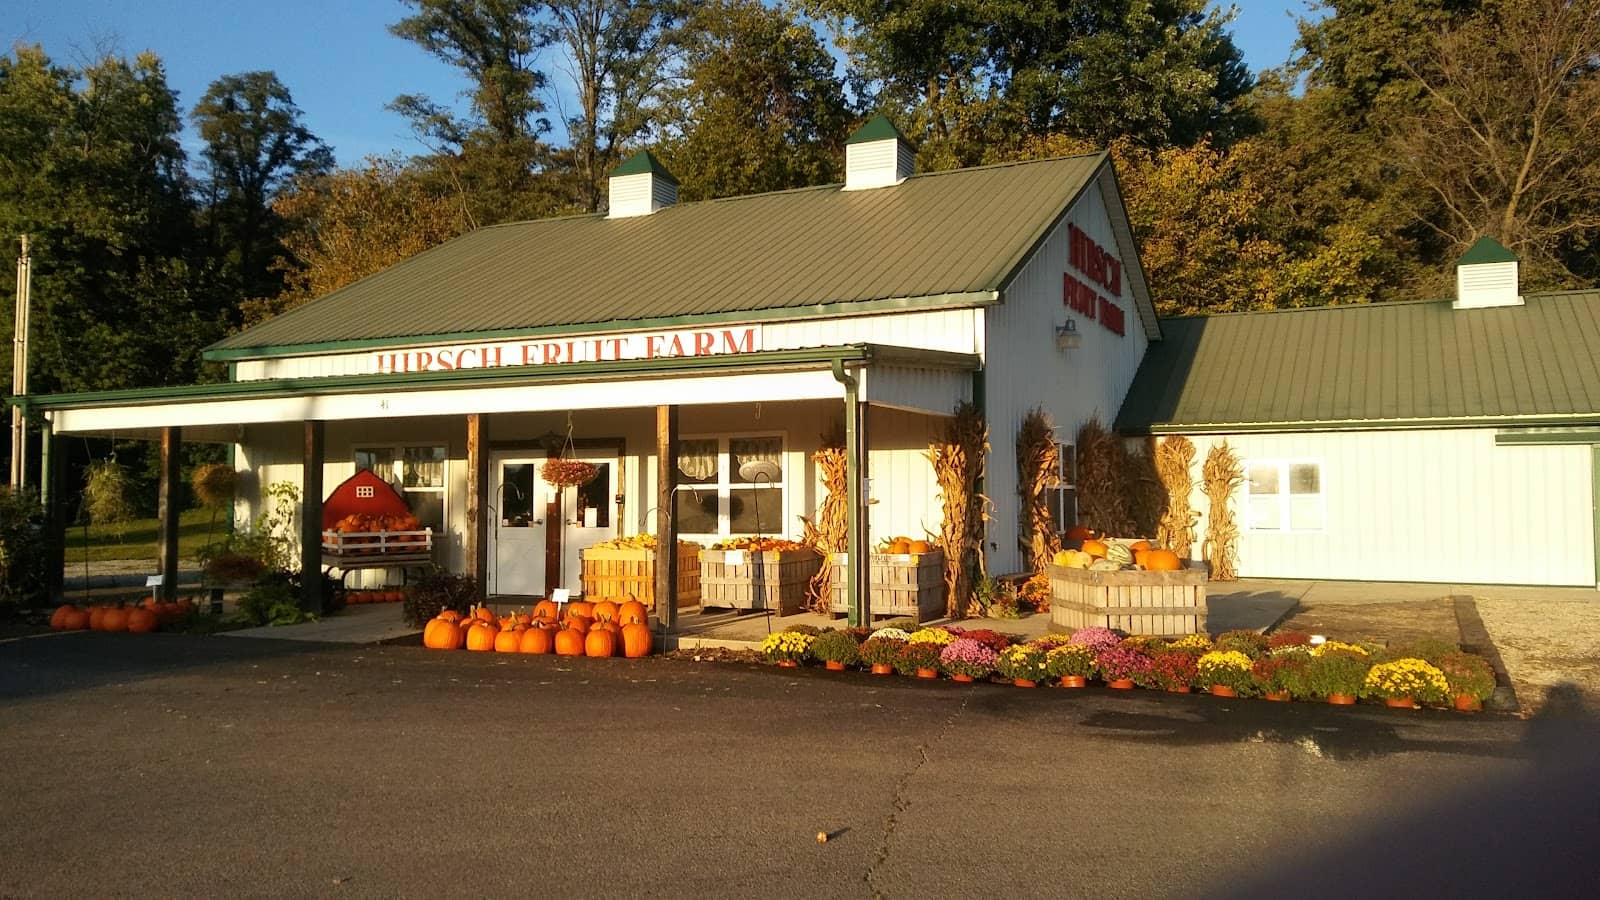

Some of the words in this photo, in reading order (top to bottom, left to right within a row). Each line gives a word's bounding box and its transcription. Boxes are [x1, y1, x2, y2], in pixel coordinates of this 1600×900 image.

[377, 345, 503, 375] HIRSCH
[520, 337, 629, 367] FRUIT
[644, 327, 758, 360] FARM
